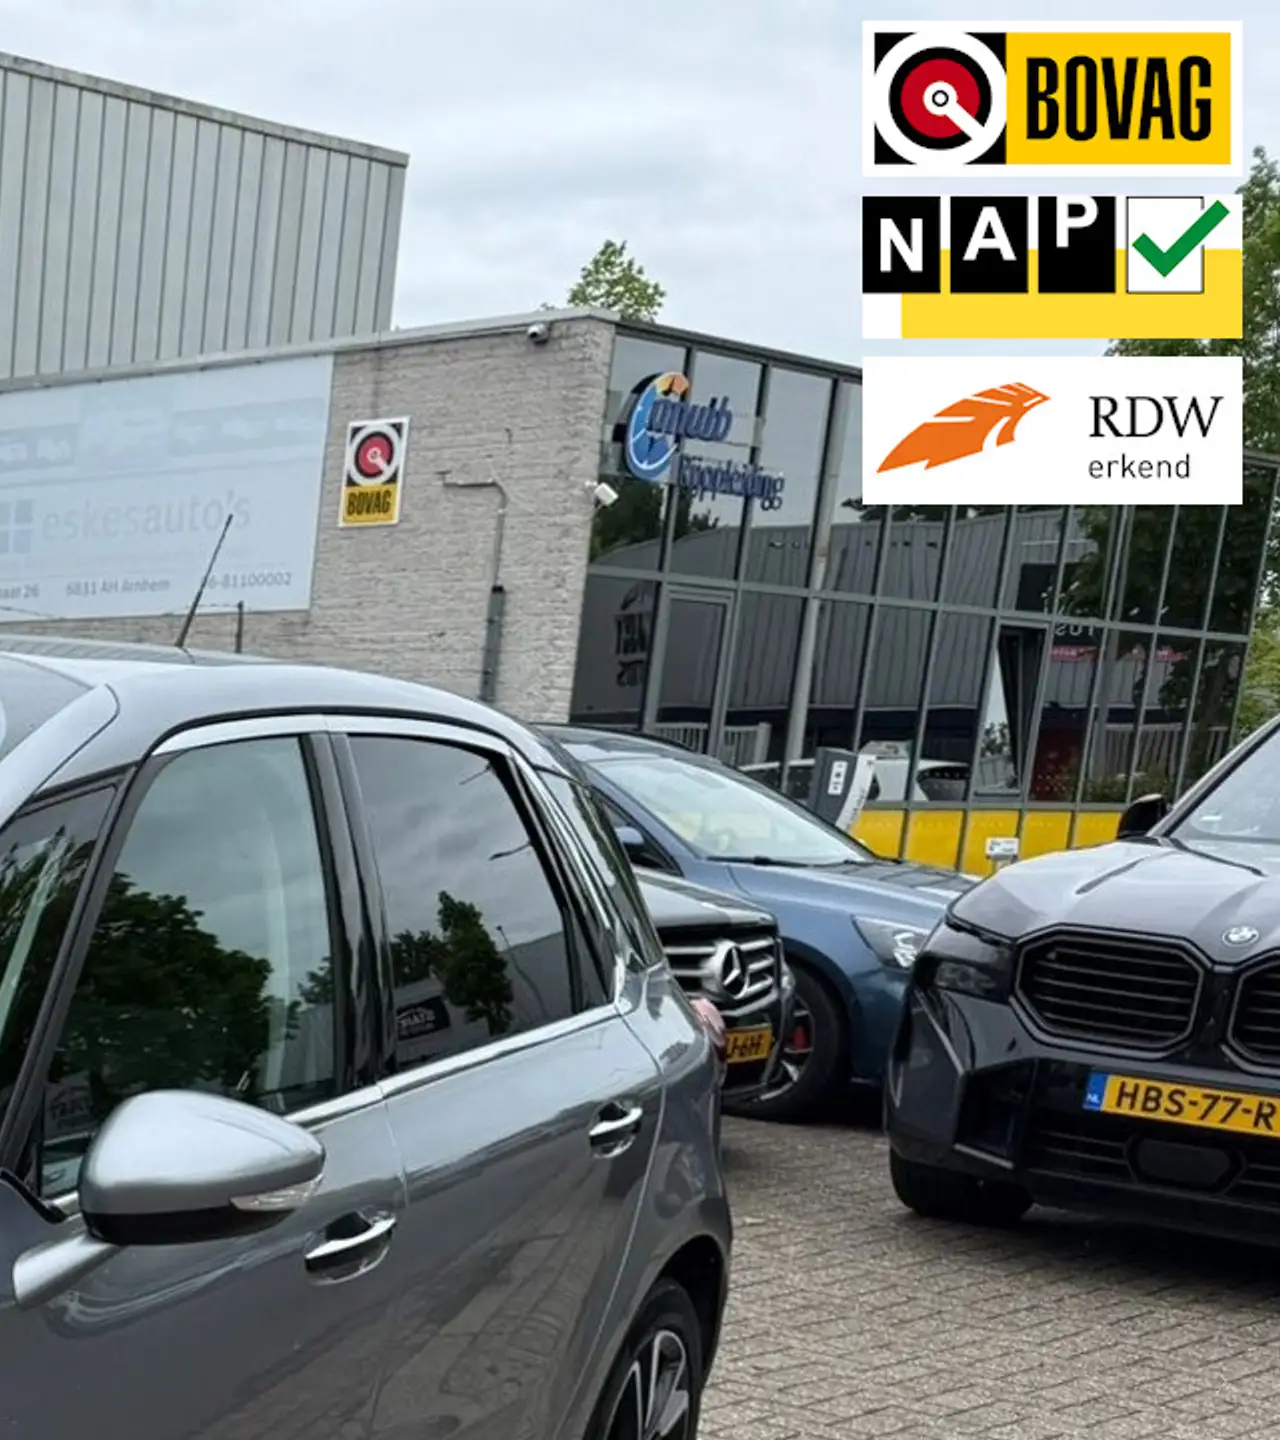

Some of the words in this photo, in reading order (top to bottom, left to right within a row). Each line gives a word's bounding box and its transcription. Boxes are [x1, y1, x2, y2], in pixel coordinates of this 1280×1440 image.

[43, 487, 251, 541] eskesauto's
[346, 490, 392, 516] BOVAG
[1115, 1080, 1277, 1131] HBS-77-R
